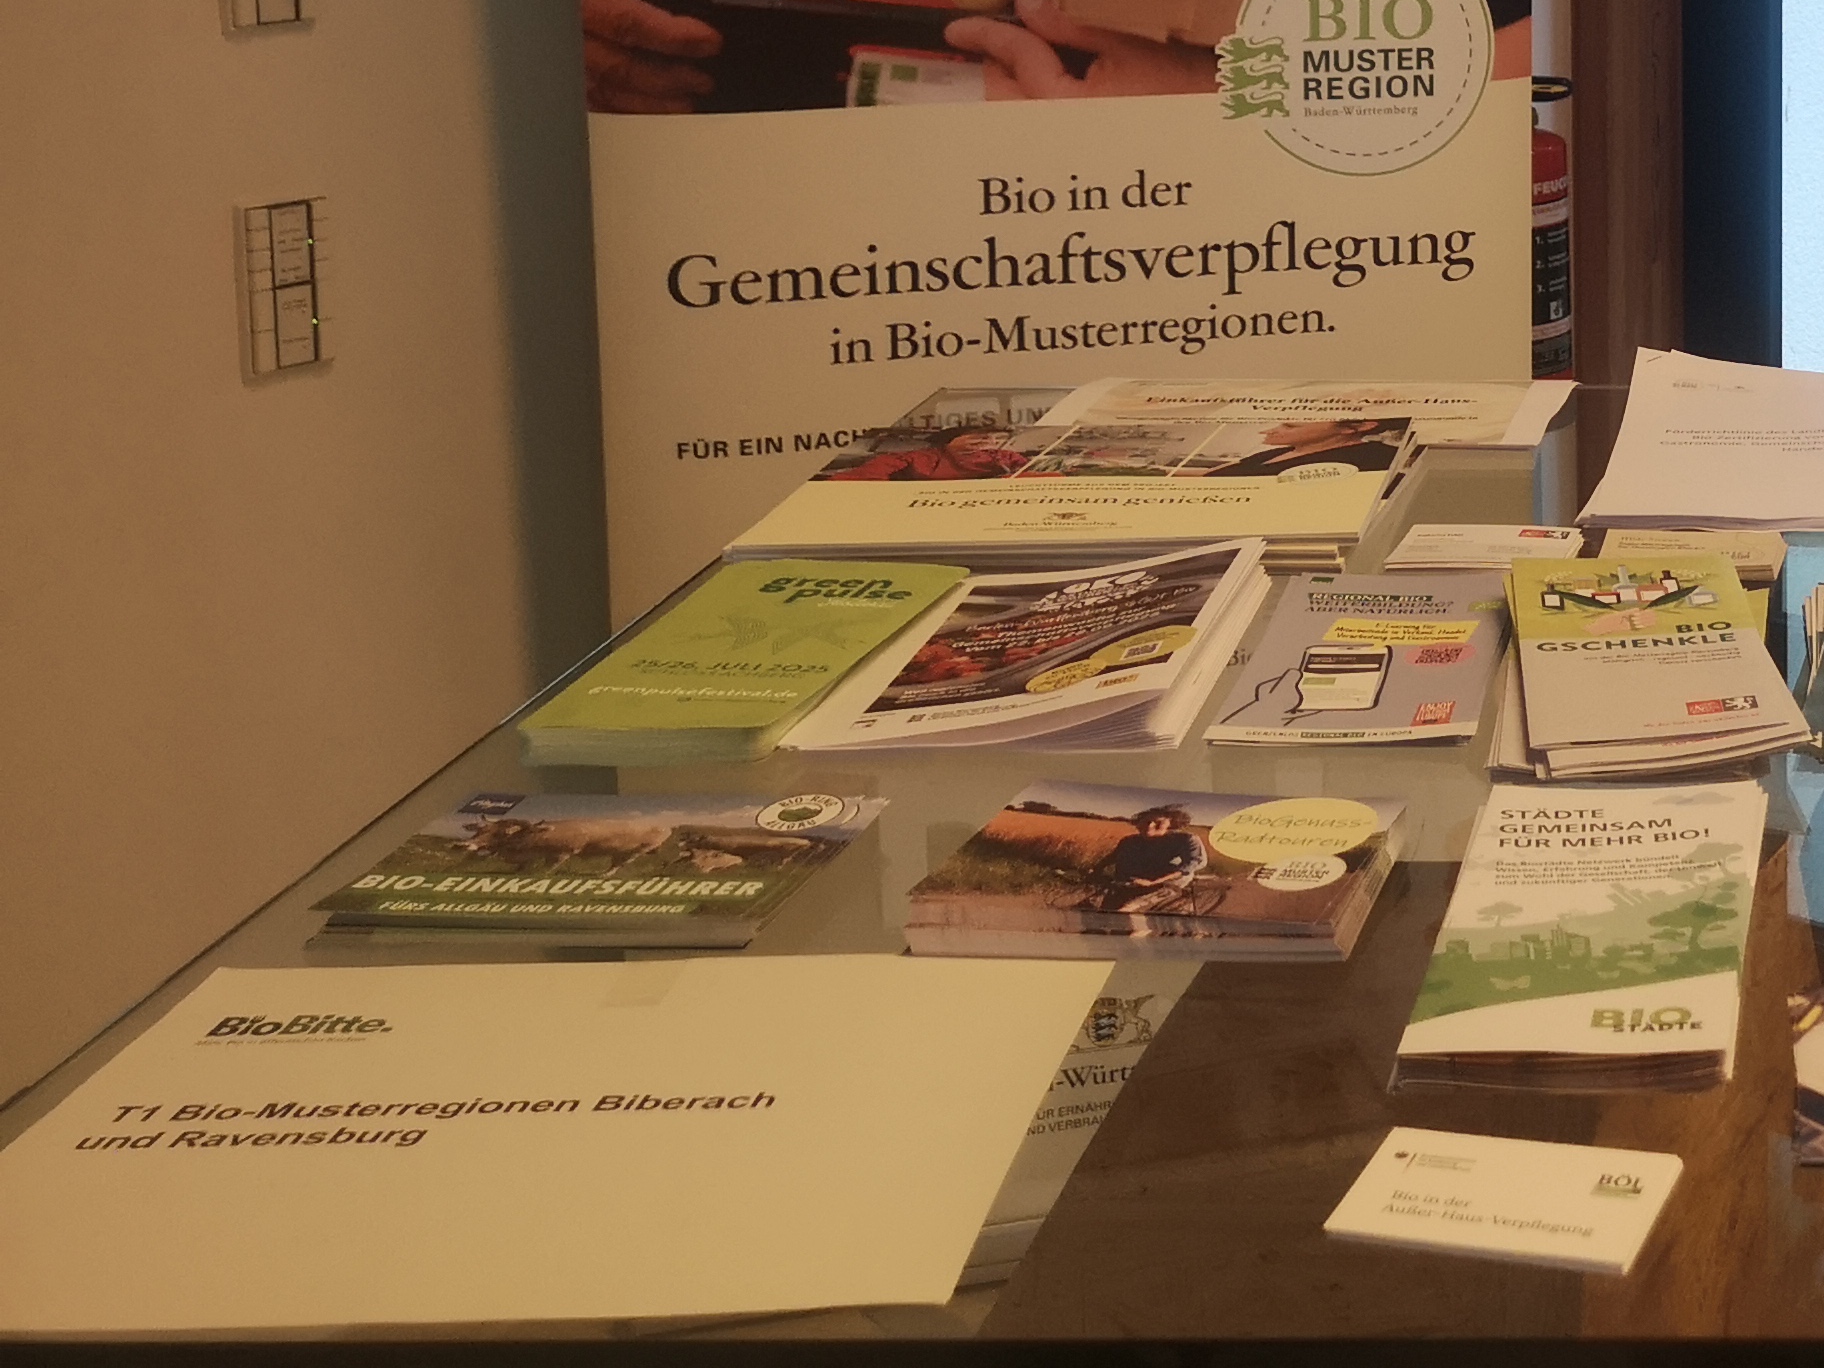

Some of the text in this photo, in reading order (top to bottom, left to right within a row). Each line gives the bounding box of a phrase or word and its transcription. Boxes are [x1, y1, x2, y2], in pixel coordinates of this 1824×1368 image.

[1303, 48, 1435, 73] MUSTER
[1304, 75, 1435, 100] REGION
[1304, 105, 1418, 117] Baden-Württemberg
[978, 170, 1193, 216] Bio in der
[666, 220, 1477, 310] Gemeinschaftsverpflegung
[830, 300, 1337, 367] in Bio-Musterregionen.
[1251, 405, 1365, 413] Verpflegung
[676, 436, 784, 460] FÜR EIN
[908, 493, 1252, 509] Bio gemeinsam genießen
[759, 576, 894, 593] green
[784, 582, 912, 604] pulse
[1311, 593, 1396, 601] REGIONAL
[1304, 606, 1350, 614] ABER
[1676, 620, 1732, 634] BIO
[1536, 633, 1737, 652] GSCHENKLE
[706, 661, 759, 672] JULI
[588, 685, 799, 699] greenpulsefestival.de
[1235, 813, 1373, 829] BioGenuss-
[1500, 808, 1605, 820] STÄDTE
[1499, 819, 1673, 835] GEMEINSAM
[1216, 831, 1349, 848] Radtouren
[1499, 828, 1711, 849] FÜR MEHR BIO!
[351, 873, 766, 898] BIO-EINKAUFSFÜHRER
[377, 899, 686, 915] FÜRS ALLGÄU UND RAVENSBURG
[206, 1013, 394, 1038] BioBitte.
[1590, 1007, 1693, 1029] BIO
[1612, 1020, 1704, 1034] STÄDTE
[113, 1090, 779, 1124] T1 Bio-Musterregionen Biberach
[74, 1125, 429, 1151] und Ravensburg
[1599, 1173, 1646, 1190] BÖL
[1392, 1189, 1421, 1201] Bio
[1444, 1195, 1473, 1208] der
